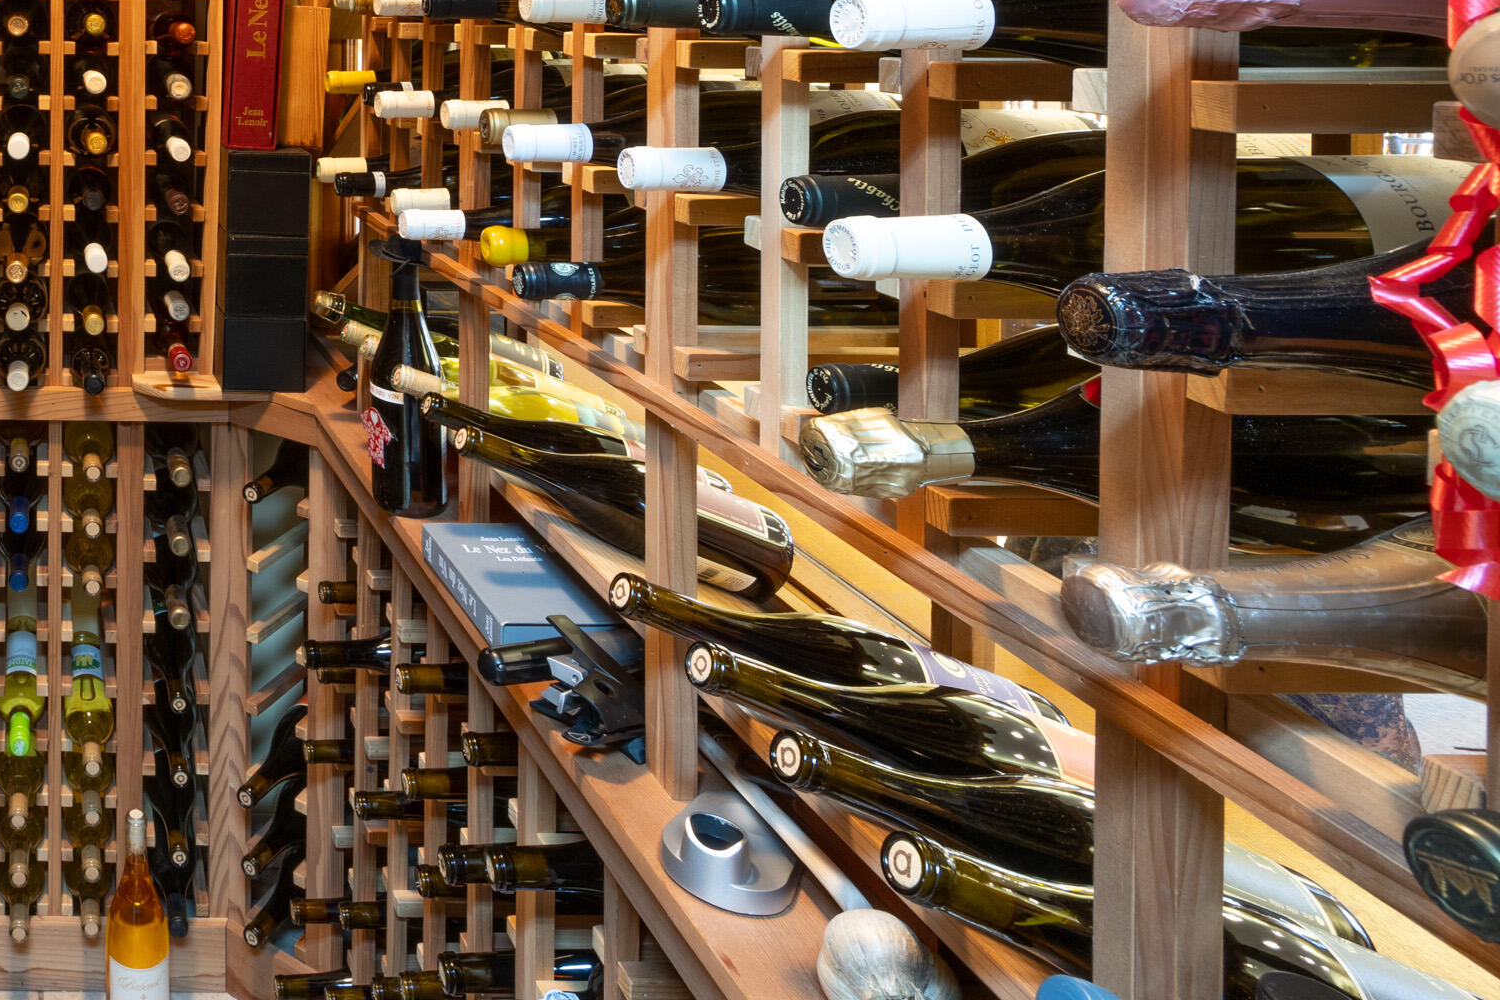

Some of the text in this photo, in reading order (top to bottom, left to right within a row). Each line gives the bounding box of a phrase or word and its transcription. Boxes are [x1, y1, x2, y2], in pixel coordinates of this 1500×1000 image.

[246, 30, 267, 60] Le
[242, 106, 265, 117] Jean
[236, 116, 269, 128] Lenoir
[461, 544, 482, 554] Le
[483, 544, 512, 554] Nez
[515, 544, 534, 554] du
